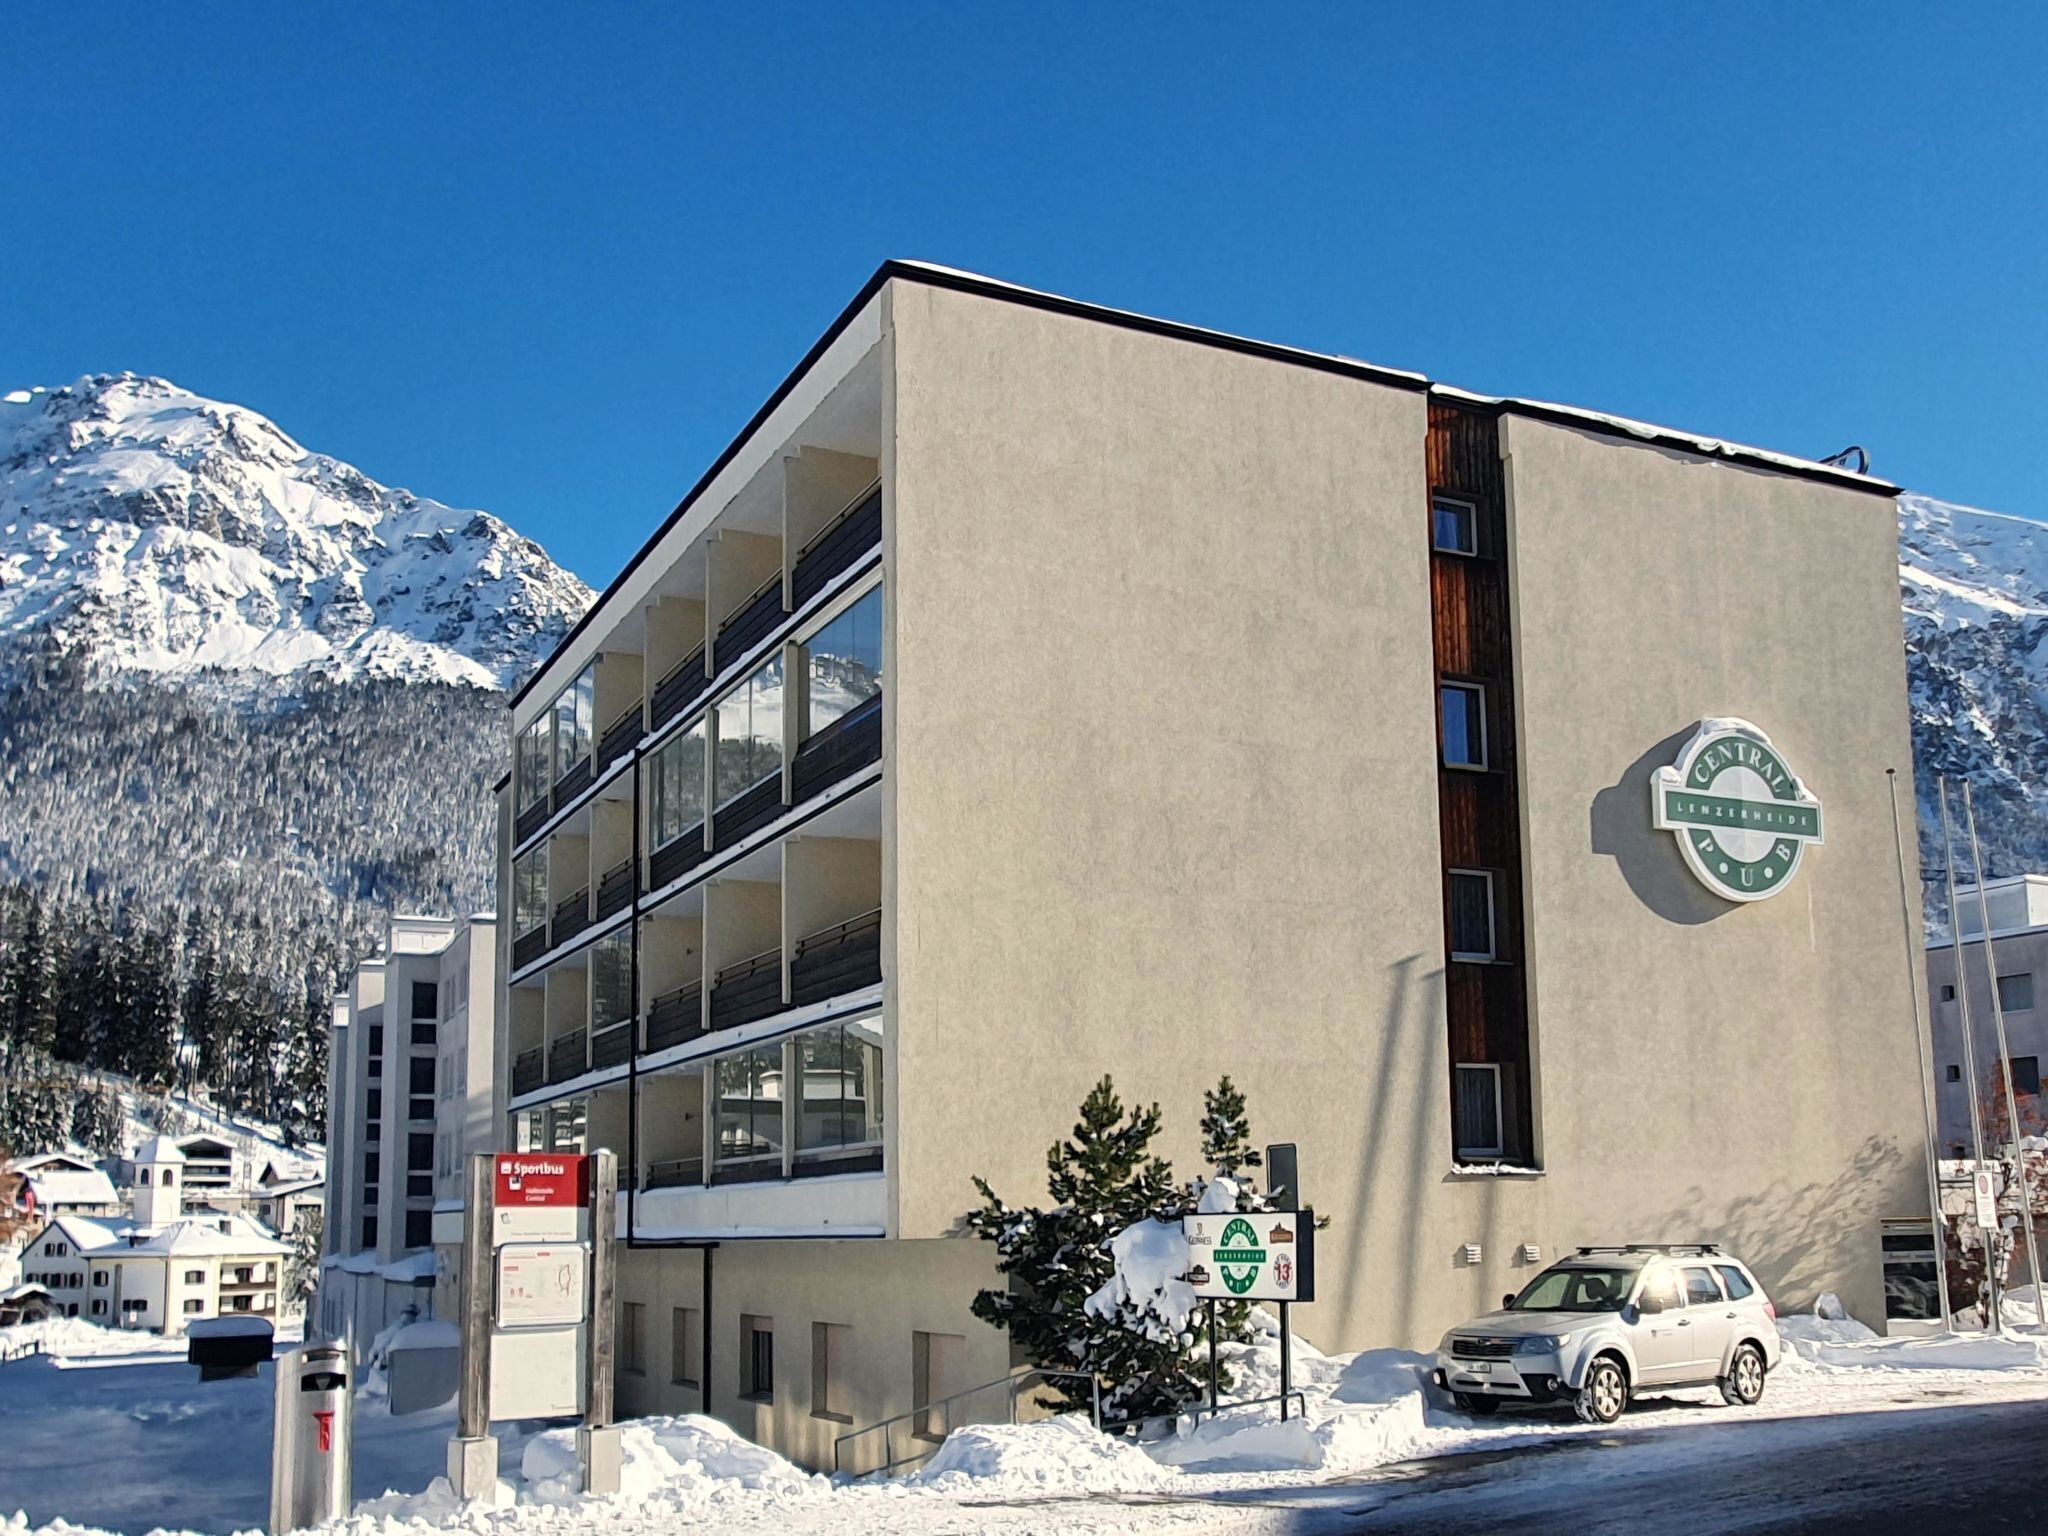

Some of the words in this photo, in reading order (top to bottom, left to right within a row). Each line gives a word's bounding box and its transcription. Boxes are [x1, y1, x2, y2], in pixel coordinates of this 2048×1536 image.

[1694, 741, 1786, 793] CENTRAL
[1677, 801, 1807, 827] LENZERHEIDE
[514, 1161, 565, 1177] Sportbus
